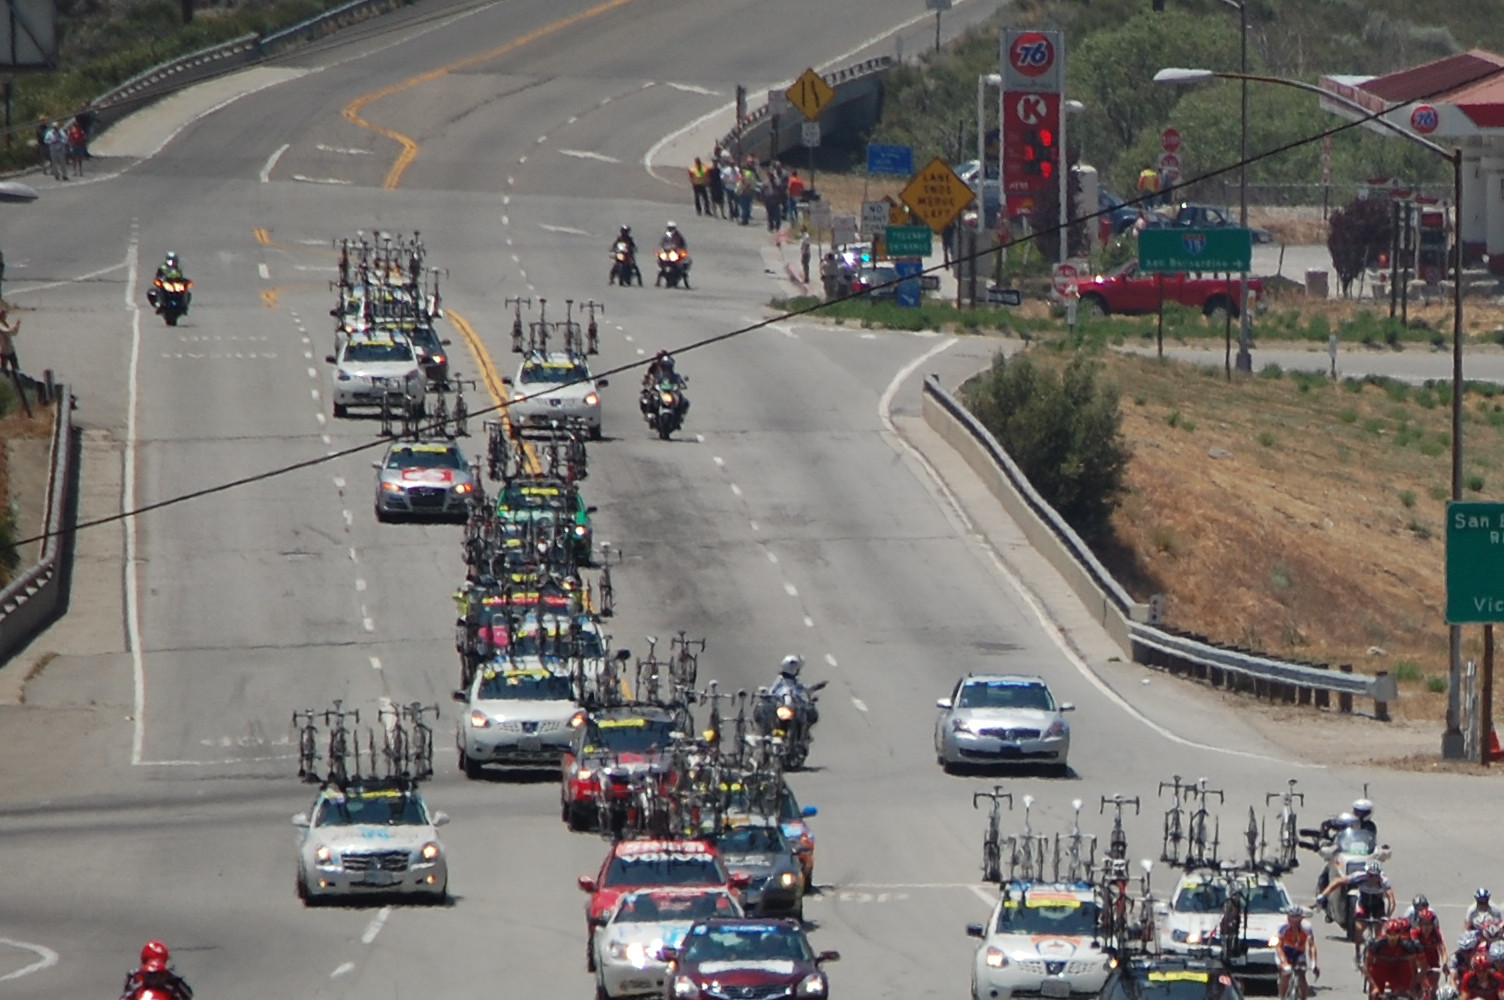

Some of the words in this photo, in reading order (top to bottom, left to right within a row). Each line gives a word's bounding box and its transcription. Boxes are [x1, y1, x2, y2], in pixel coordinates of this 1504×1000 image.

[1018, 41, 1047, 66] 76
[1019, 96, 1046, 124] K
[1415, 110, 1434, 126] 76
[922, 173, 950, 181] LANE
[923, 184, 951, 194] ENDS
[917, 197, 955, 207] MERGE
[869, 205, 884, 213] NO
[923, 208, 951, 218] LEFT
[1454, 513, 1490, 530] San
